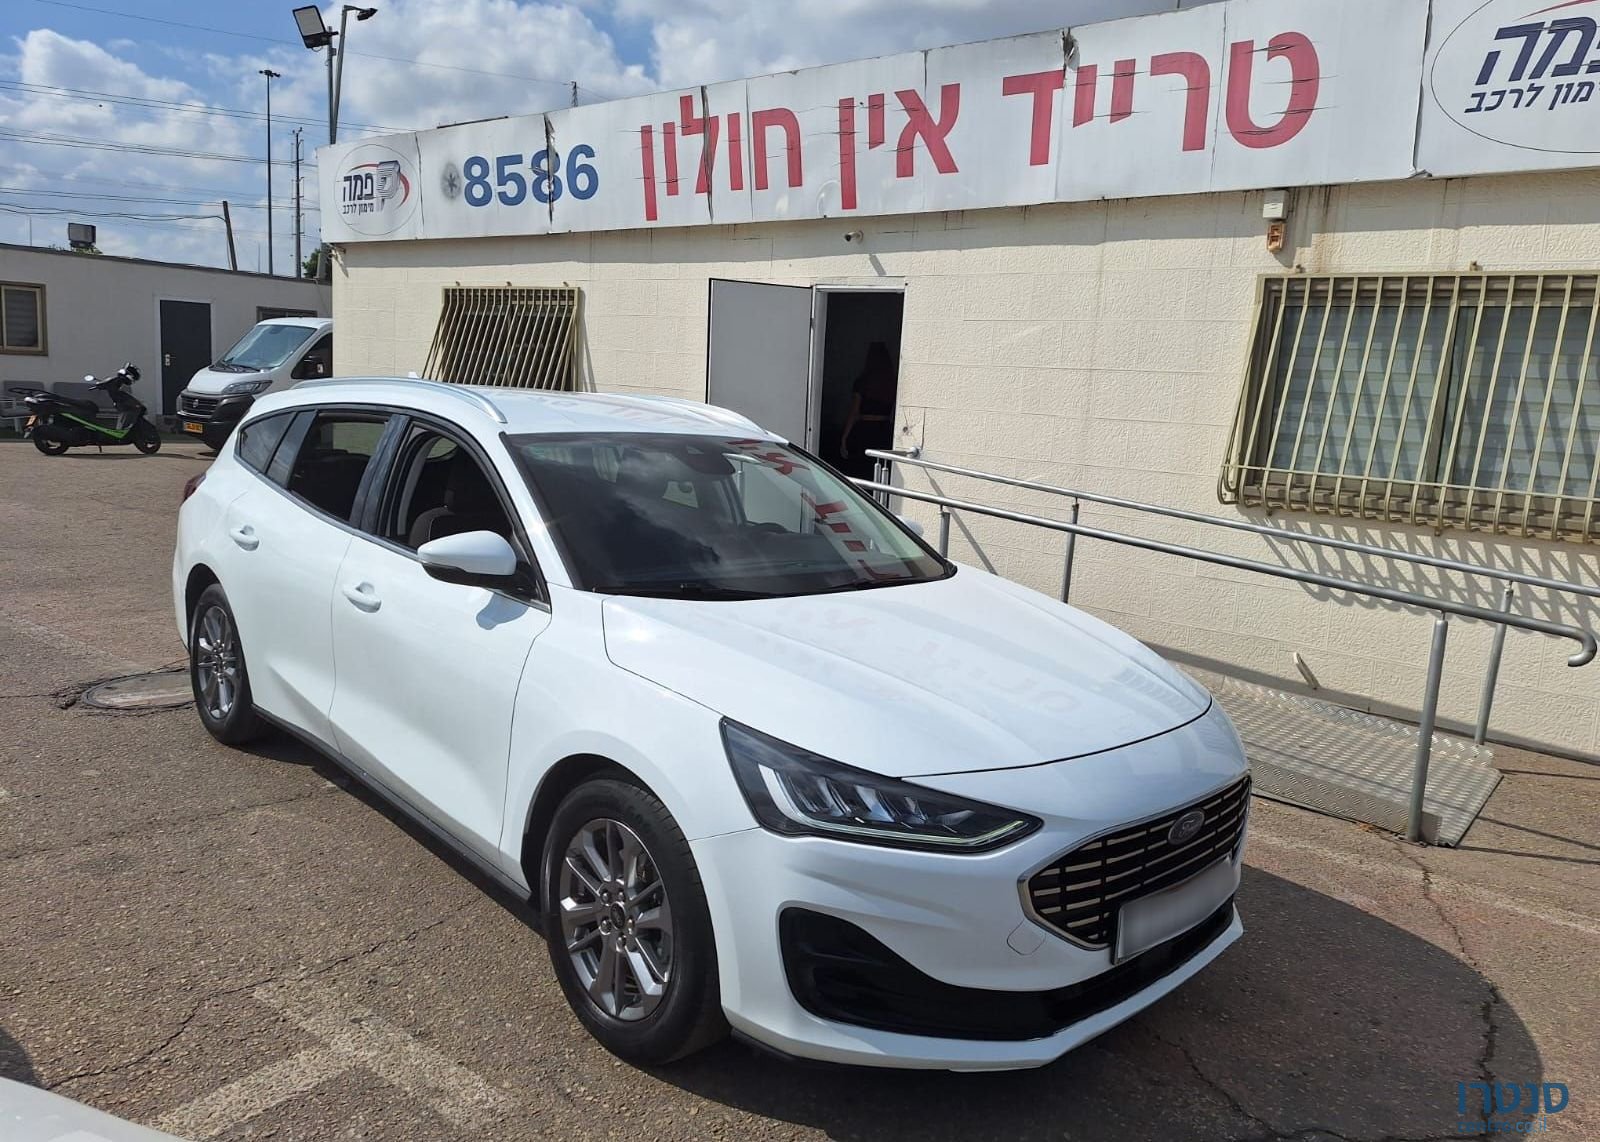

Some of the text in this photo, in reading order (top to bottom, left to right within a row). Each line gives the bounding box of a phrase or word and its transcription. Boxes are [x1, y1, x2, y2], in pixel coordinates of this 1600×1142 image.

[1475, 16, 1600, 86] מה
[1463, 81, 1600, 114] מון לרכב
[640, 31, 1320, 222] טרייד אין חולון
[343, 172, 374, 202] פמה
